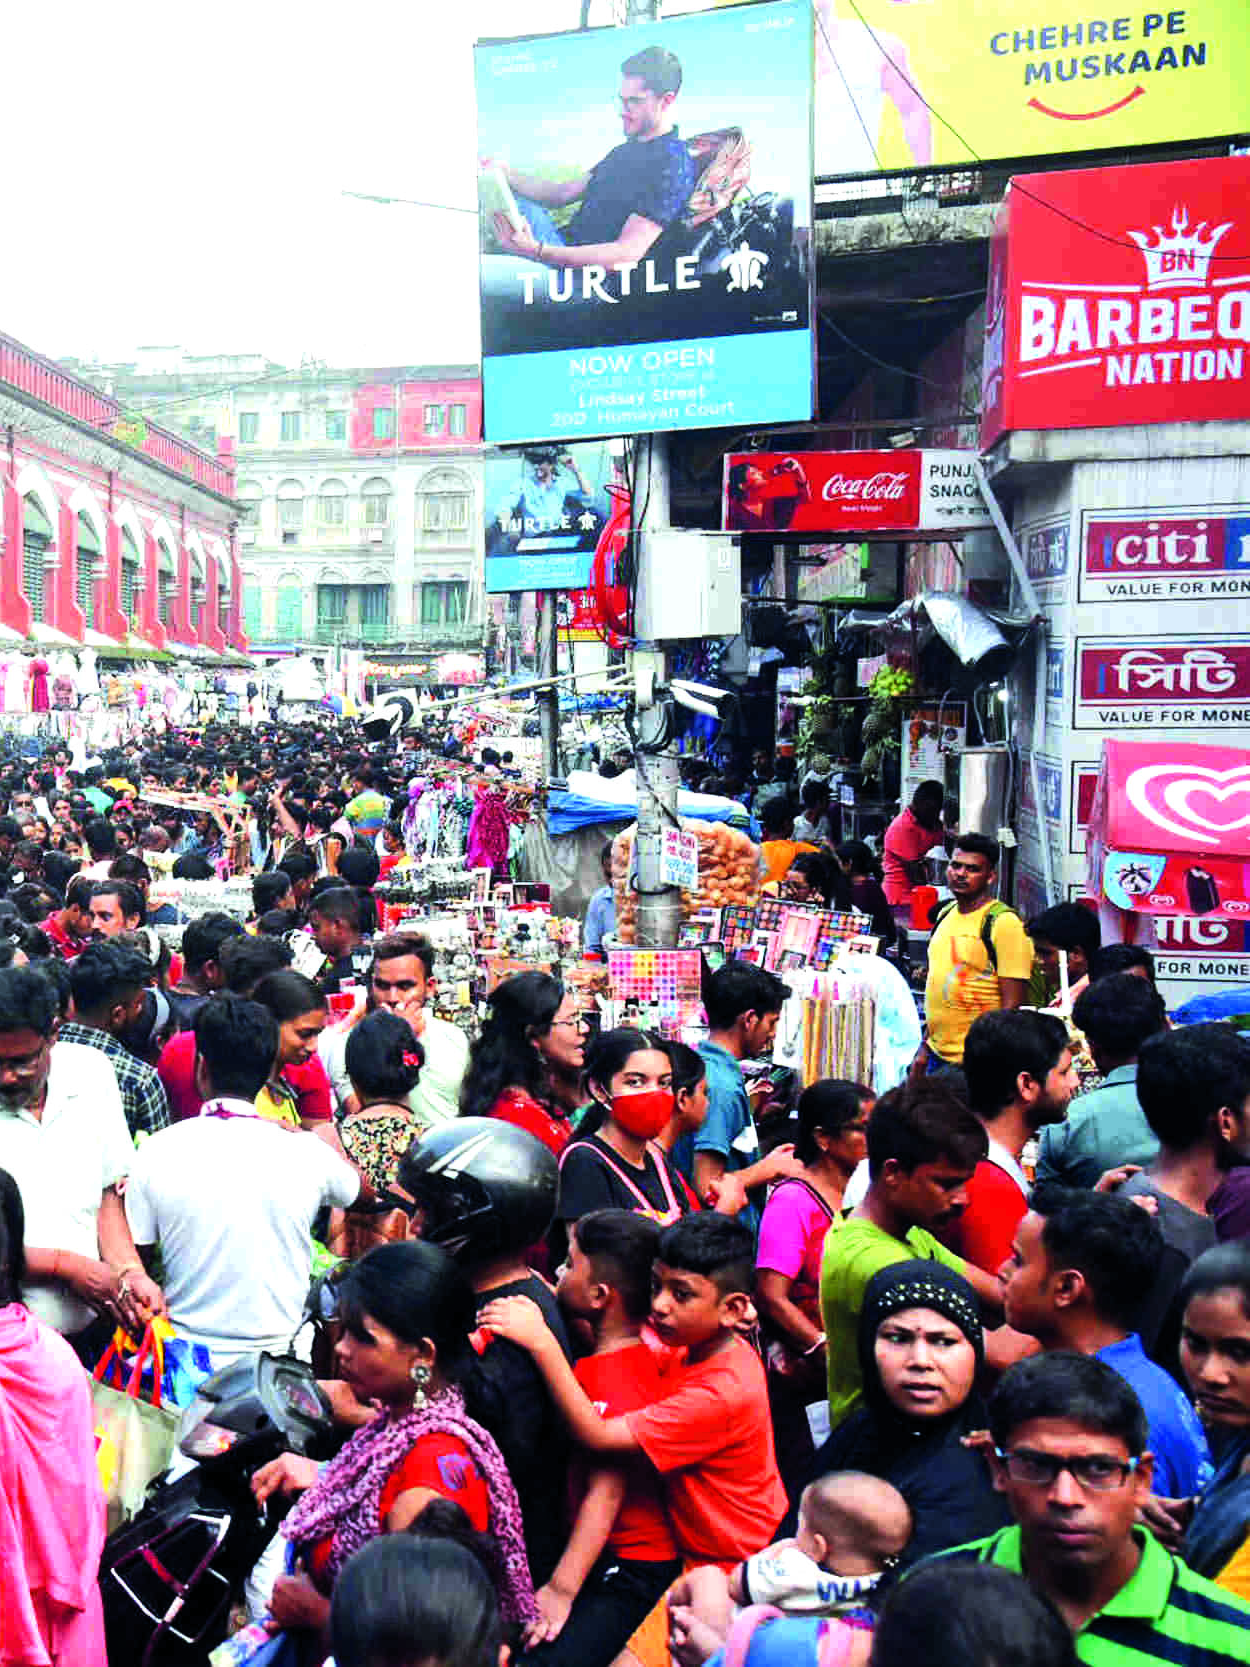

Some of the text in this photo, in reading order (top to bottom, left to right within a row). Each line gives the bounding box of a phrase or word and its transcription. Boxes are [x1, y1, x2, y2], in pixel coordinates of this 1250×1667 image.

[989, 10, 1186, 56] CHEHRE PE
[1024, 42, 1207, 86] MUSKAAN
[1161, 249, 1196, 272] BN
[516, 254, 702, 304] TURTLE
[569, 347, 715, 377] NOW OPEN
[1106, 348, 1244, 387] NATION
[578, 384, 707, 409] Lindsay Street
[685, 401, 735, 417] Court
[930, 463, 975, 479] PUNJ
[497, 514, 572, 534] TURTLE
[1115, 521, 1212, 566] citi
[1107, 582, 1166, 596] VALUE
[1169, 582, 1204, 594] FOR
[1110, 650, 1237, 694] সিটি
[1099, 711, 1154, 723] VALUE
[1161, 710, 1195, 722] FOR
[1157, 961, 1191, 974] FOR
